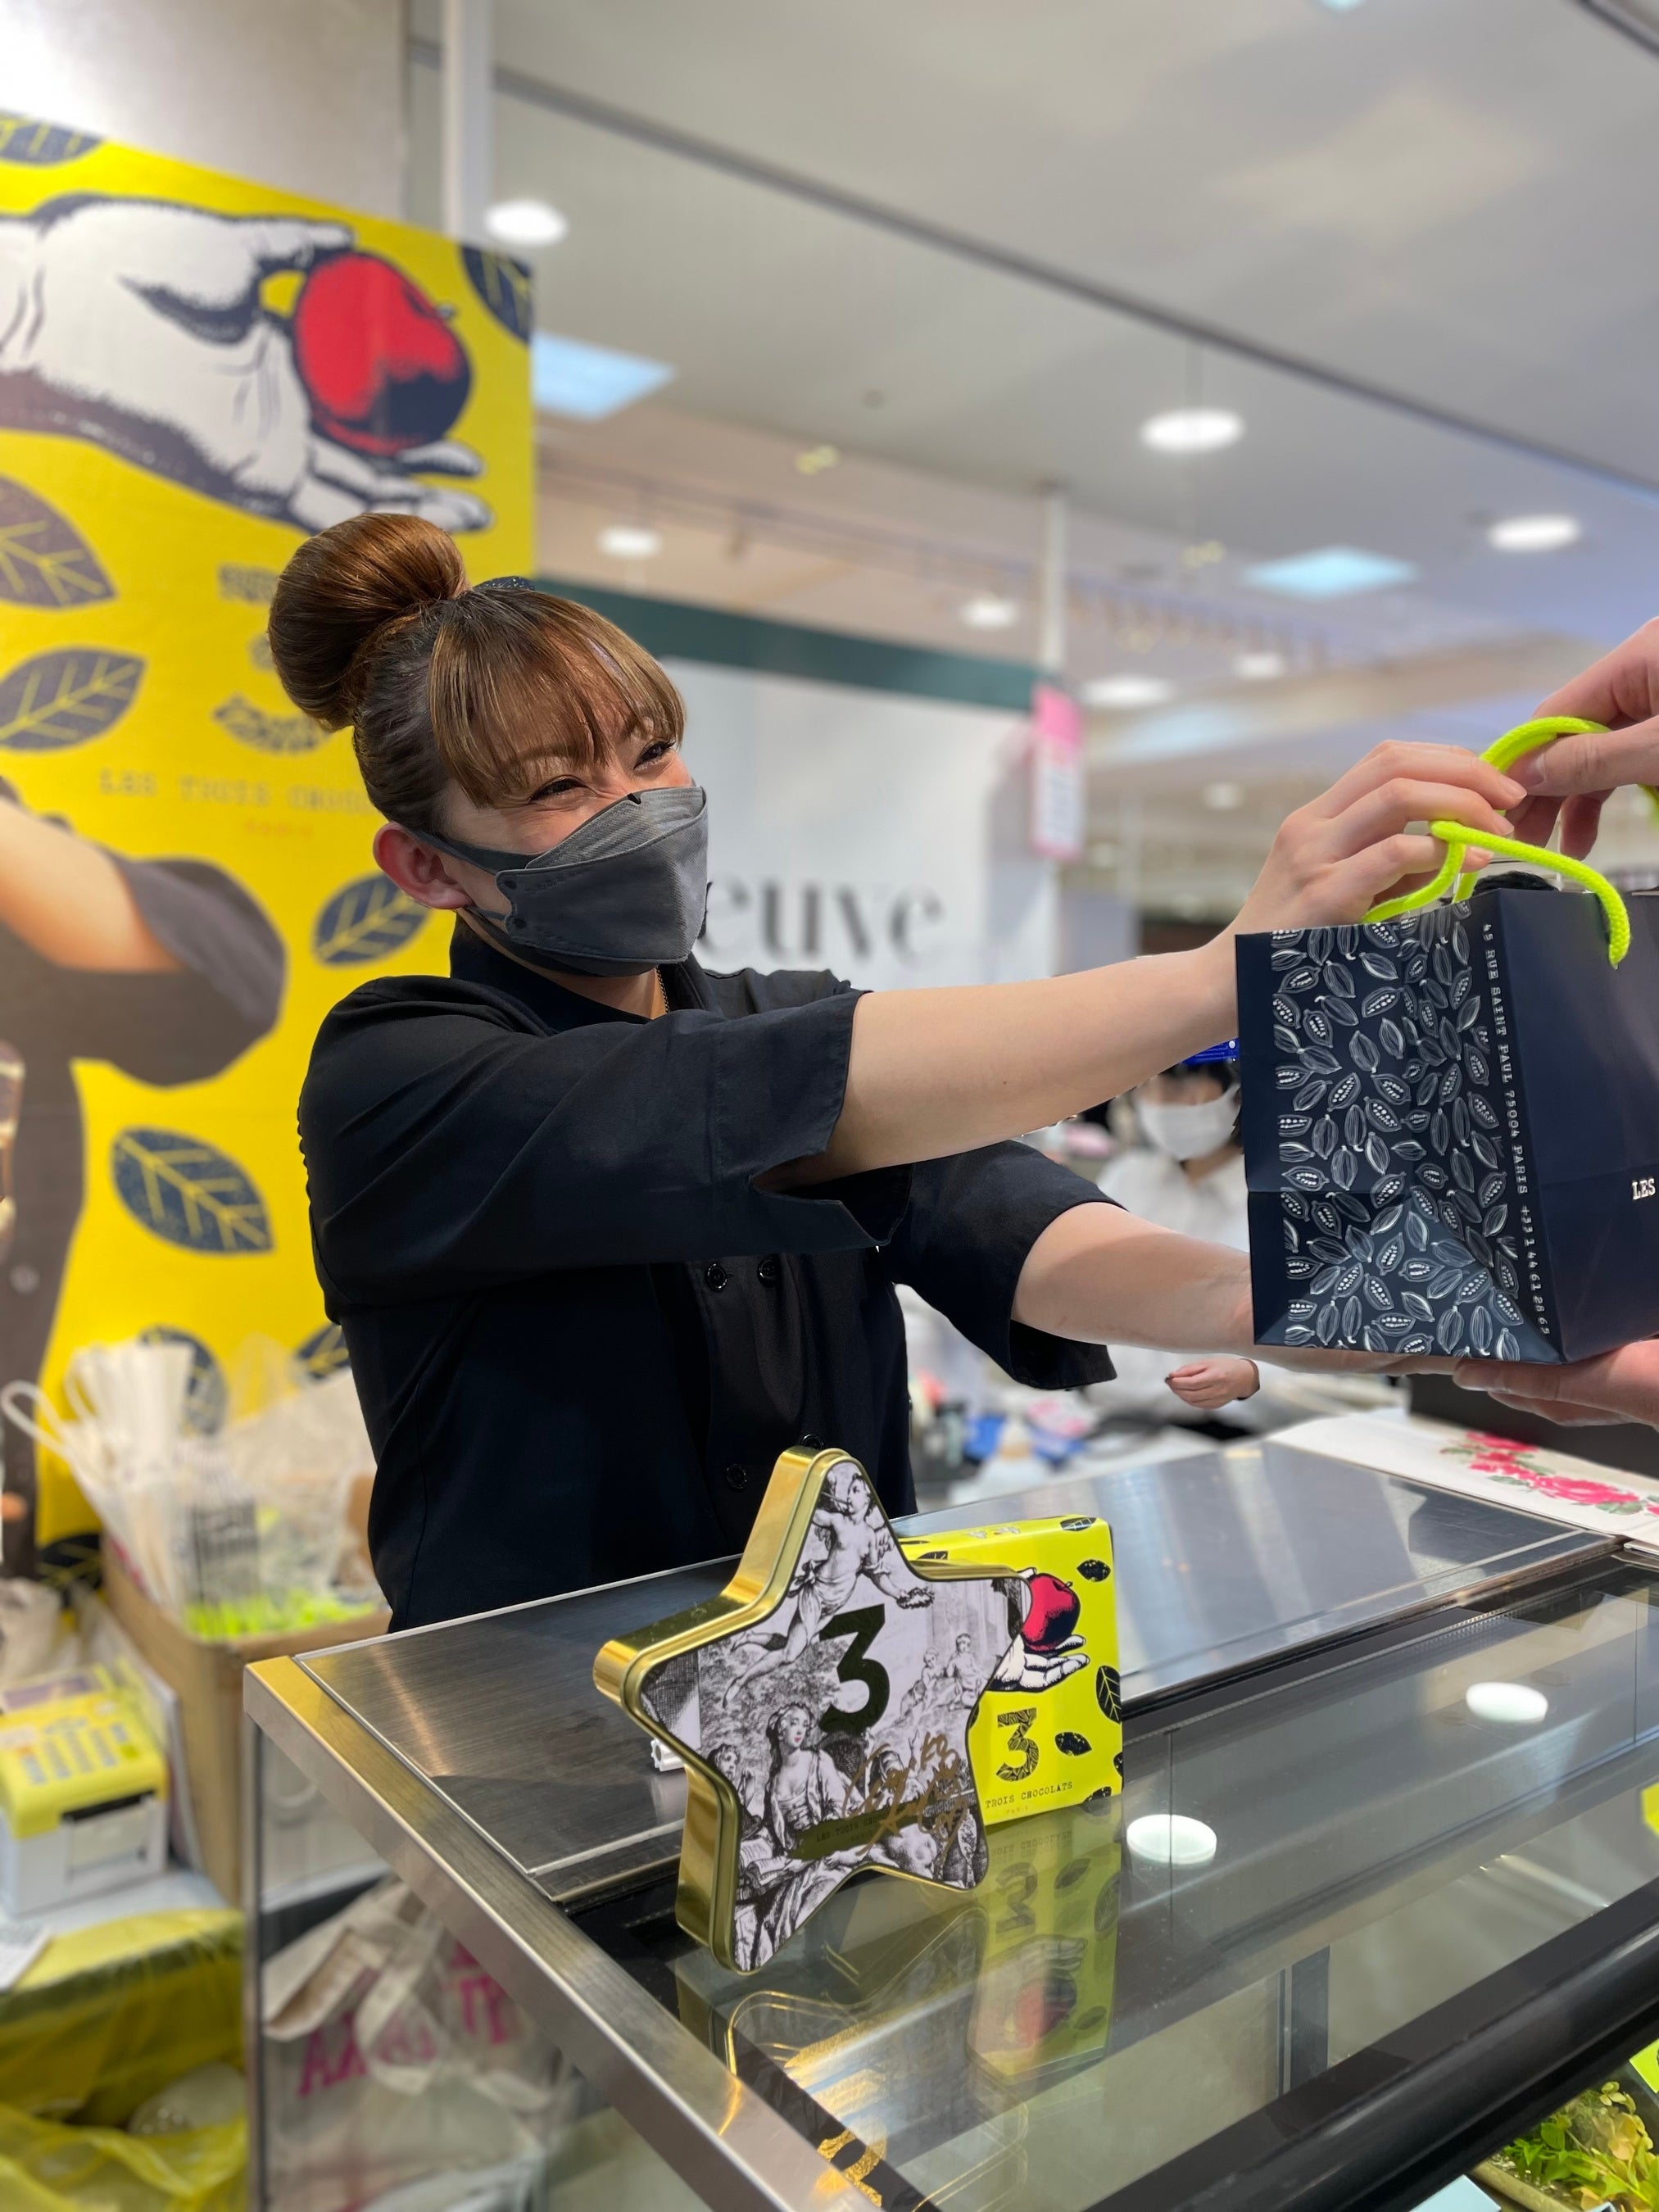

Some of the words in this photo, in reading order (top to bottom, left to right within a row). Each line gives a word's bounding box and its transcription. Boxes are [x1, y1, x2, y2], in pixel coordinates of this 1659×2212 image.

[1482, 924, 1494, 941] 45
[1485, 950, 1498, 980] RUE
[1490, 987, 1507, 1036] SAINT
[1498, 1044, 1512, 1083] PAUL
[1504, 1090, 1520, 1138] 75004
[1512, 1145, 1528, 1194] PARIS
[1632, 1178, 1656, 1199] LES
[1521, 1206, 1533, 1233] +33
[1527, 1251, 1538, 1268] 44
[1530, 1273, 1541, 1290] 61
[1533, 1296, 1545, 1312] 28
[1538, 1317, 1550, 1335] 65
[818, 1603, 890, 1734] 3
[996, 1707, 1039, 1782] 3
[986, 1795, 1014, 1809] TROIS
[1021, 1781, 1073, 1800] CHOCOLATS
